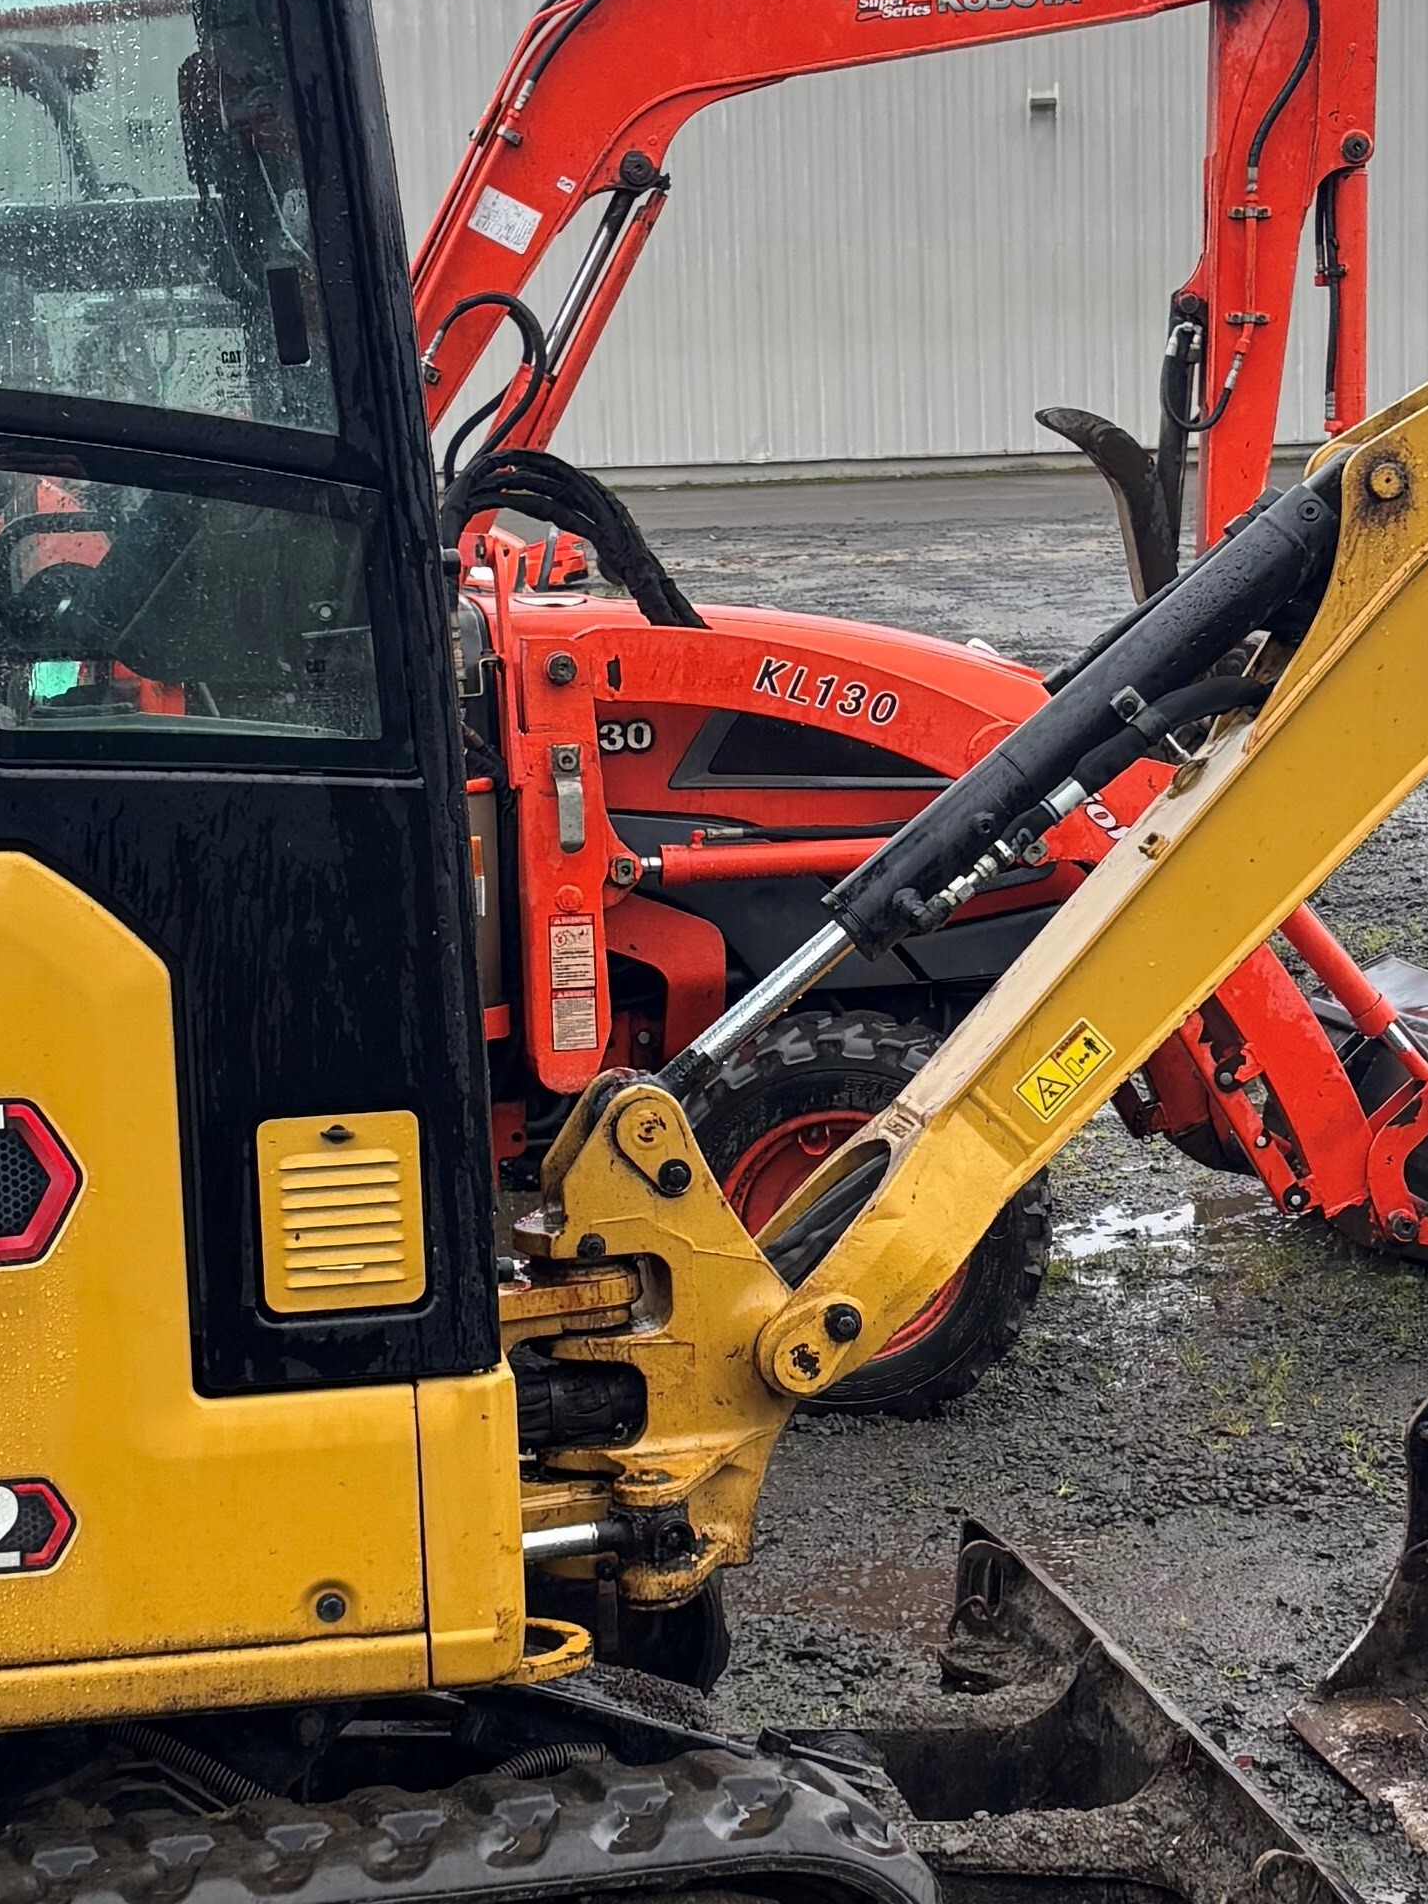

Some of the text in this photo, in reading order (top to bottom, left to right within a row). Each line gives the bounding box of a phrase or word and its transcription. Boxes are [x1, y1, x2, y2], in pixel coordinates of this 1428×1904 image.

[882, 2, 932, 19] Series
[753, 656, 900, 726] KL130
[598, 721, 653, 752] 30
